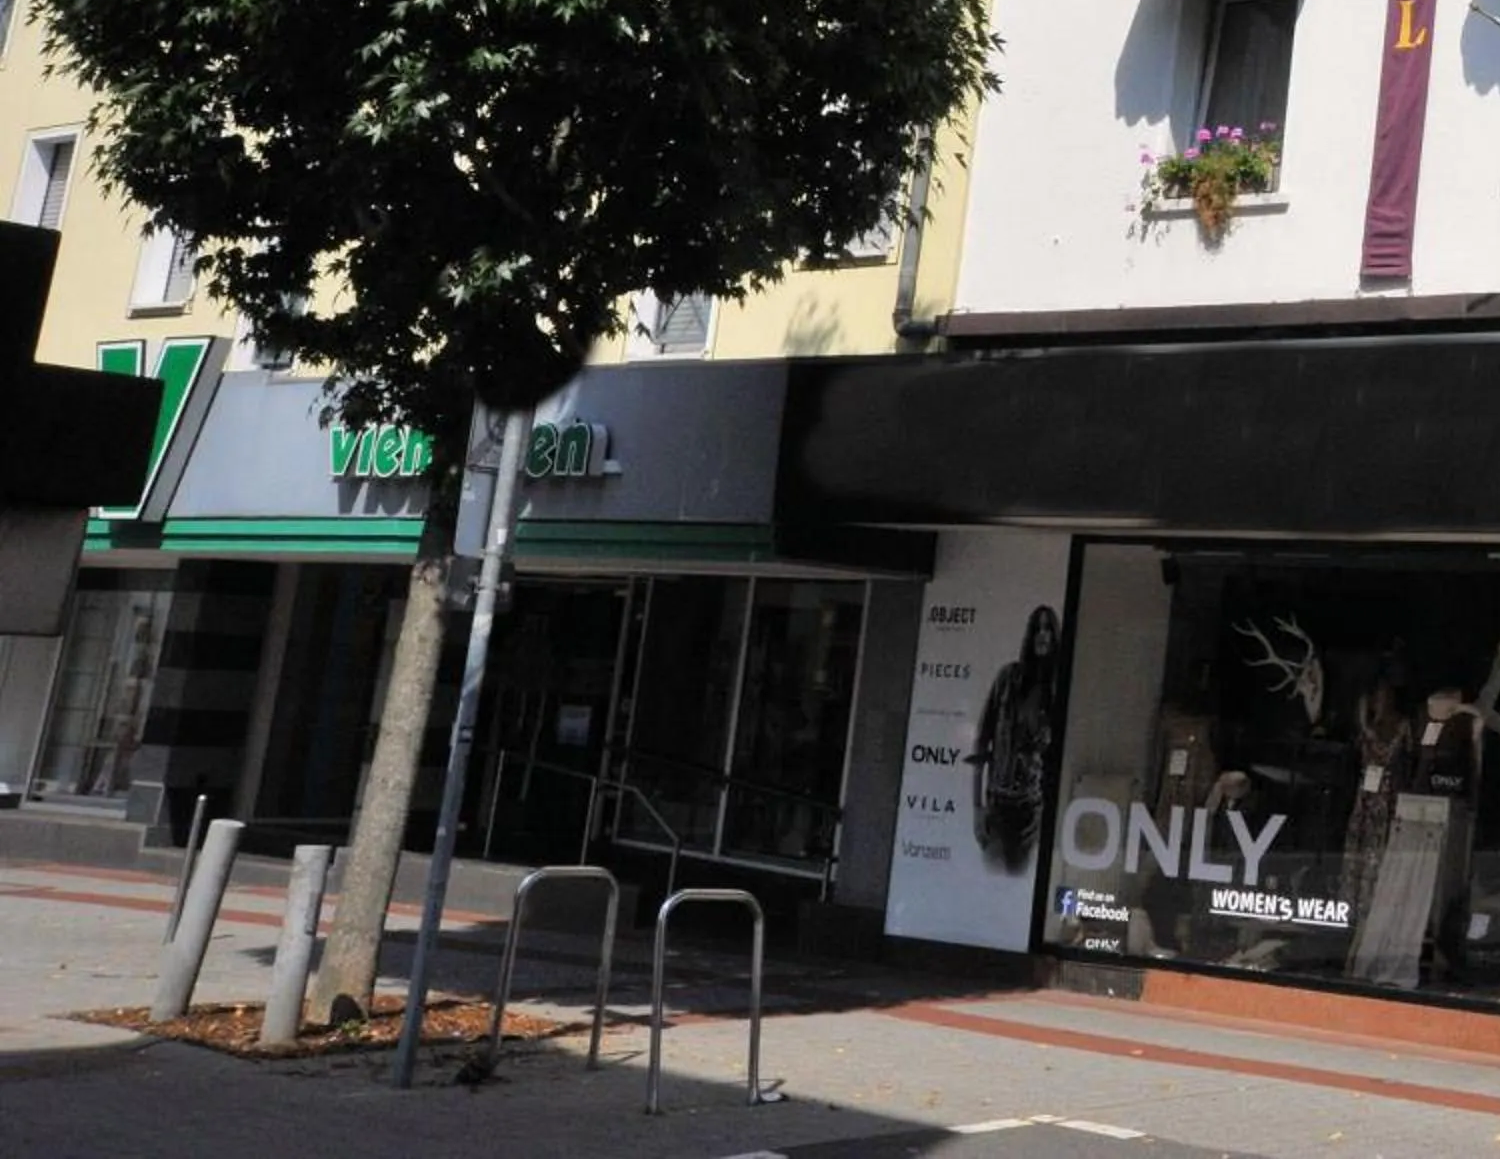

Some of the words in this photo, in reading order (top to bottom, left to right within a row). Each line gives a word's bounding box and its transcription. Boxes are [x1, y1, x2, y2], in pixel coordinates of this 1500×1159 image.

[921, 662, 971, 679] PIECES
[911, 744, 961, 766] ONLY
[907, 795, 955, 813] VILA
[1062, 797, 1288, 886] ONLY
[1075, 901, 1129, 922] Facebook
[1297, 897, 1350, 922] WEAR
